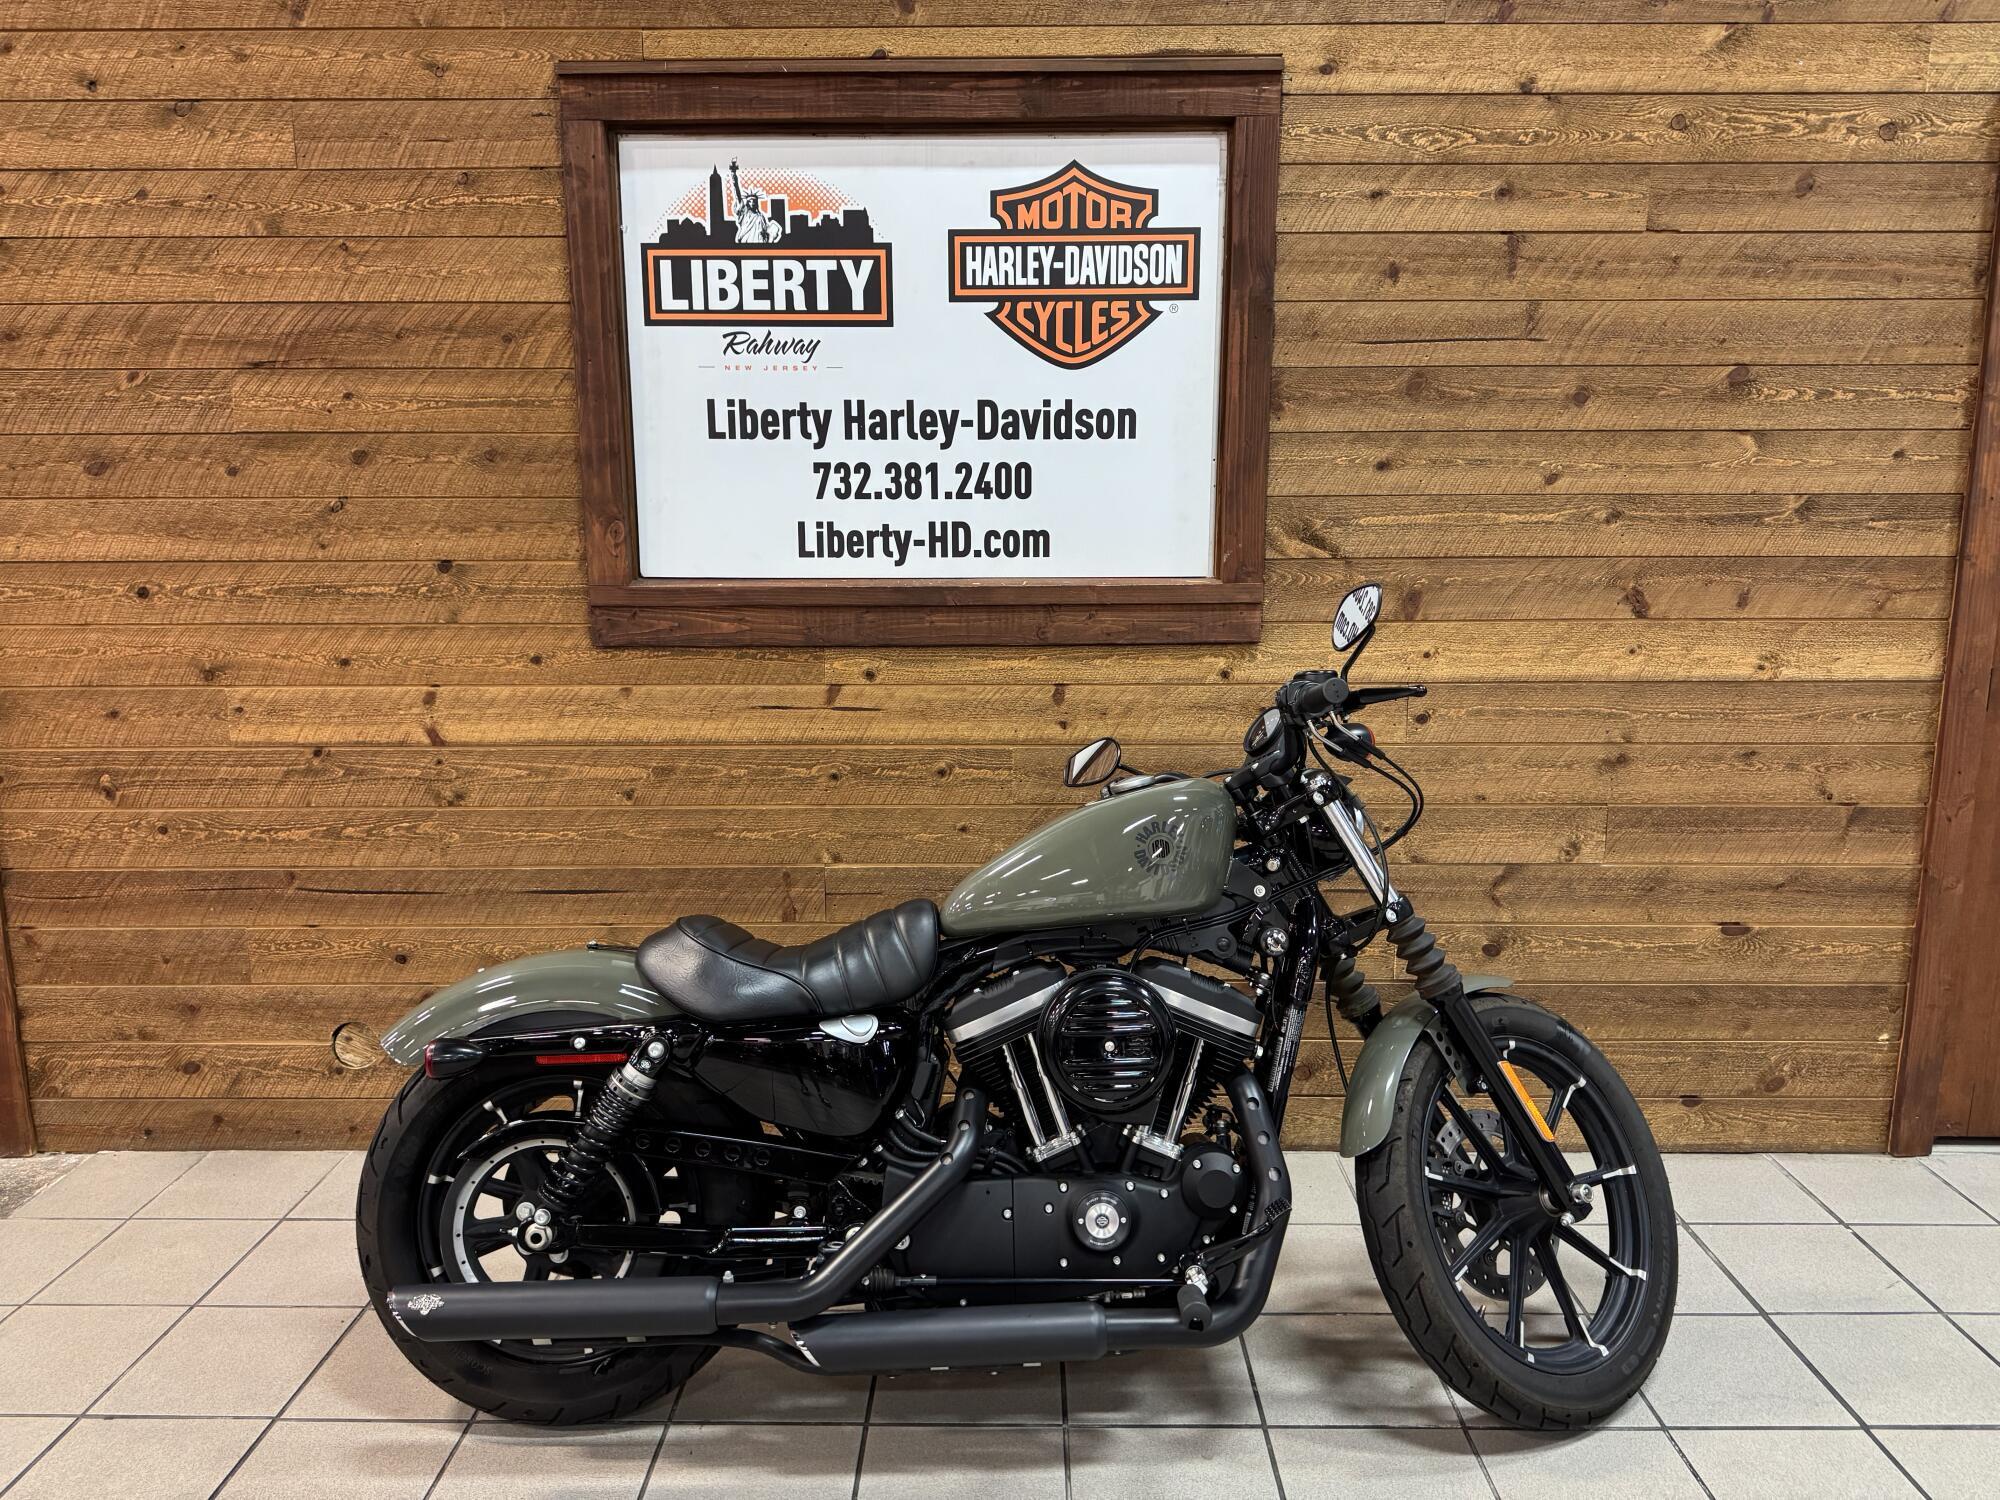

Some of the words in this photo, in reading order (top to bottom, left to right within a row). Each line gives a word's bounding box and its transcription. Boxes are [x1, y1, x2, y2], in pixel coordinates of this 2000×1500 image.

[1017, 181, 1132, 229] MOTOR
[660, 259, 875, 311] LIBERTY
[966, 243, 1184, 287] HARLEY-DAVIDSON
[722, 330, 821, 363] Rahway
[1016, 301, 1130, 354] CYCLES
[763, 364, 818, 372] JERSEY
[707, 399, 832, 449] Liberty
[844, 399, 1136, 450] Harley-Davidson
[813, 462, 1031, 500] 732.381.2400
[798, 521, 1050, 566] Liberty-HD.com
